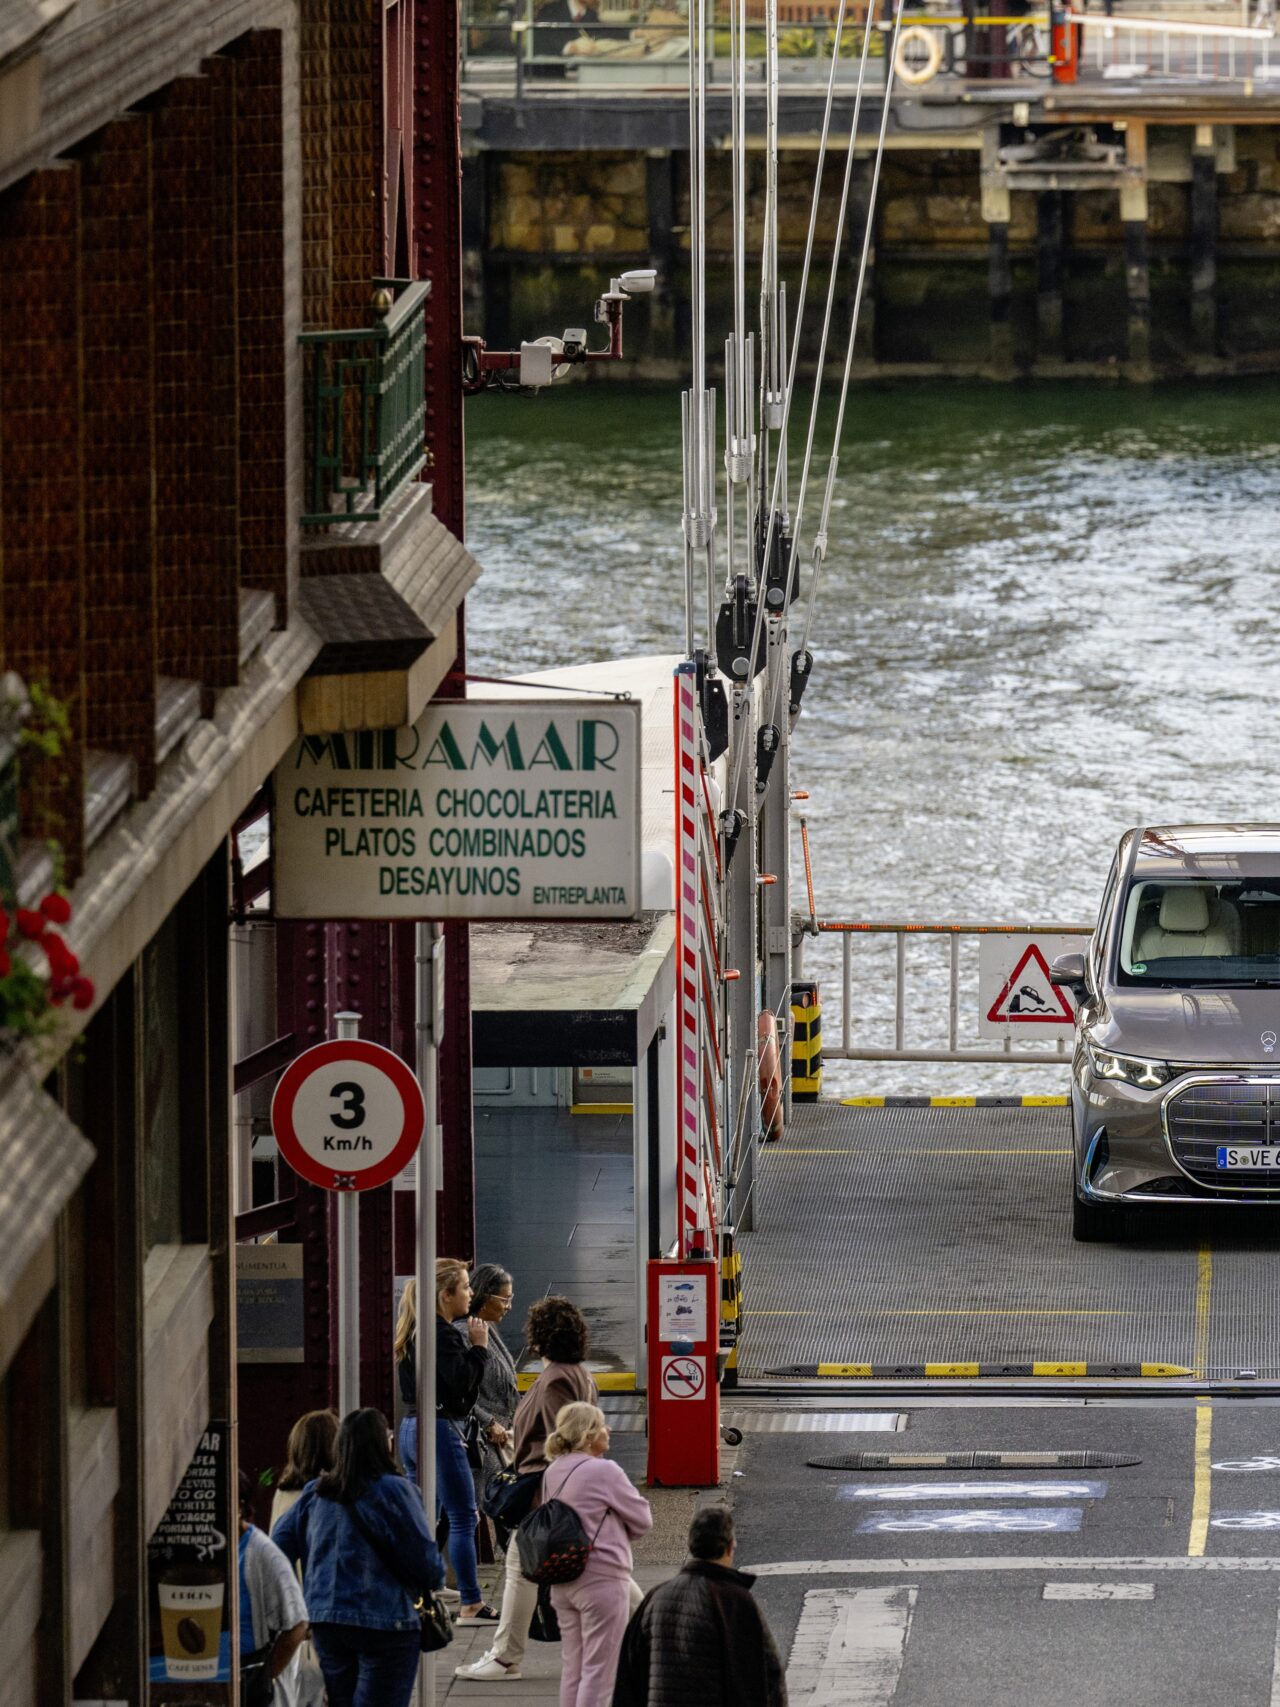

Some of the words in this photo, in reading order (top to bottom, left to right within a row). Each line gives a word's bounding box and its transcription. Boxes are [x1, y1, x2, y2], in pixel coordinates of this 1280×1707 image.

[296, 719, 619, 772] MIRAMAR
[294, 787, 424, 818] CAFETERIA
[436, 788, 617, 819] CHOCOLATERIA
[325, 827, 416, 857] PLATOS
[429, 828, 586, 858] COMBINADOS
[379, 866, 521, 897] DESAYUNOS
[533, 886, 626, 905] ENTREPLANTA
[329, 1081, 366, 1130] 3
[323, 1135, 373, 1151] Km/h
[1228, 1150, 1239, 1166] S
[1250, 1150, 1271, 1166] VE
[200, 1432, 220, 1451] AR
[192, 1455, 216, 1465] FEA
[186, 1467, 217, 1477] ORTAR
[181, 1479, 216, 1488] EVAR
[169, 1500, 216, 1510] PORTER
